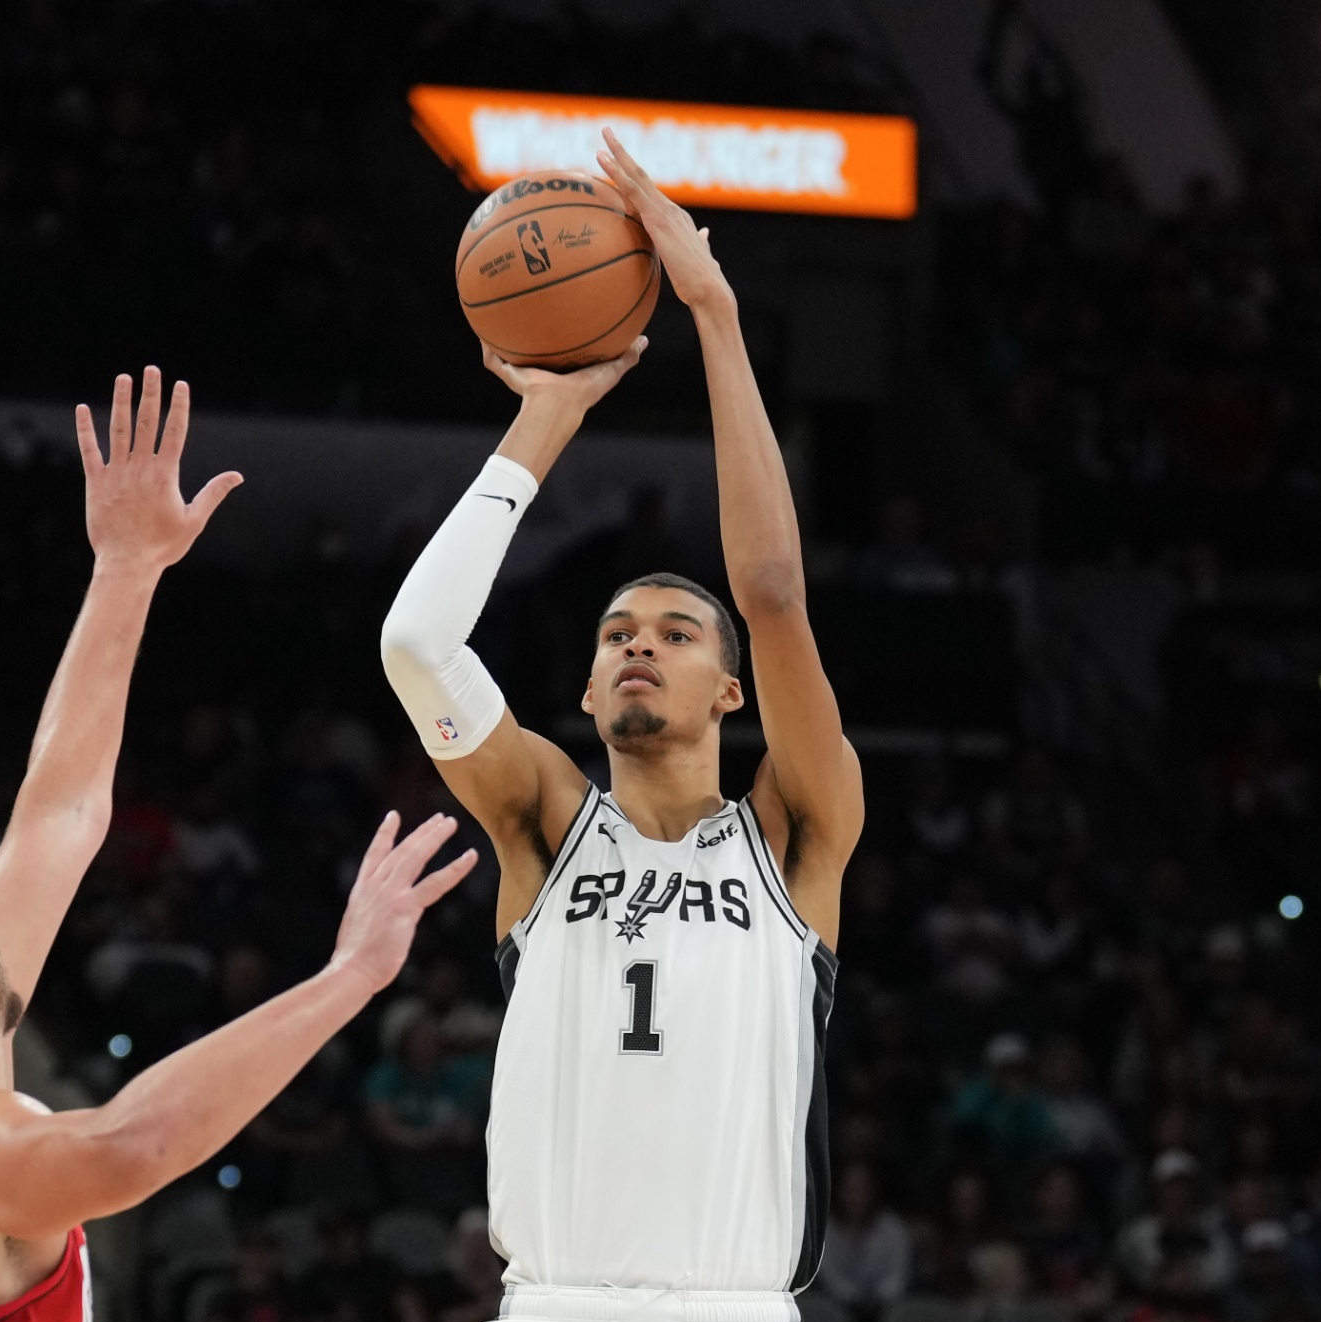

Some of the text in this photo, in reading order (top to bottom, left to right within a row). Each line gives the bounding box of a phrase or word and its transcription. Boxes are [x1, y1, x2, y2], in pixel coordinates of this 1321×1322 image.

[469, 178, 596, 231] Wilson
[565, 869, 751, 936] SPURS
[618, 959, 665, 1056] 1
